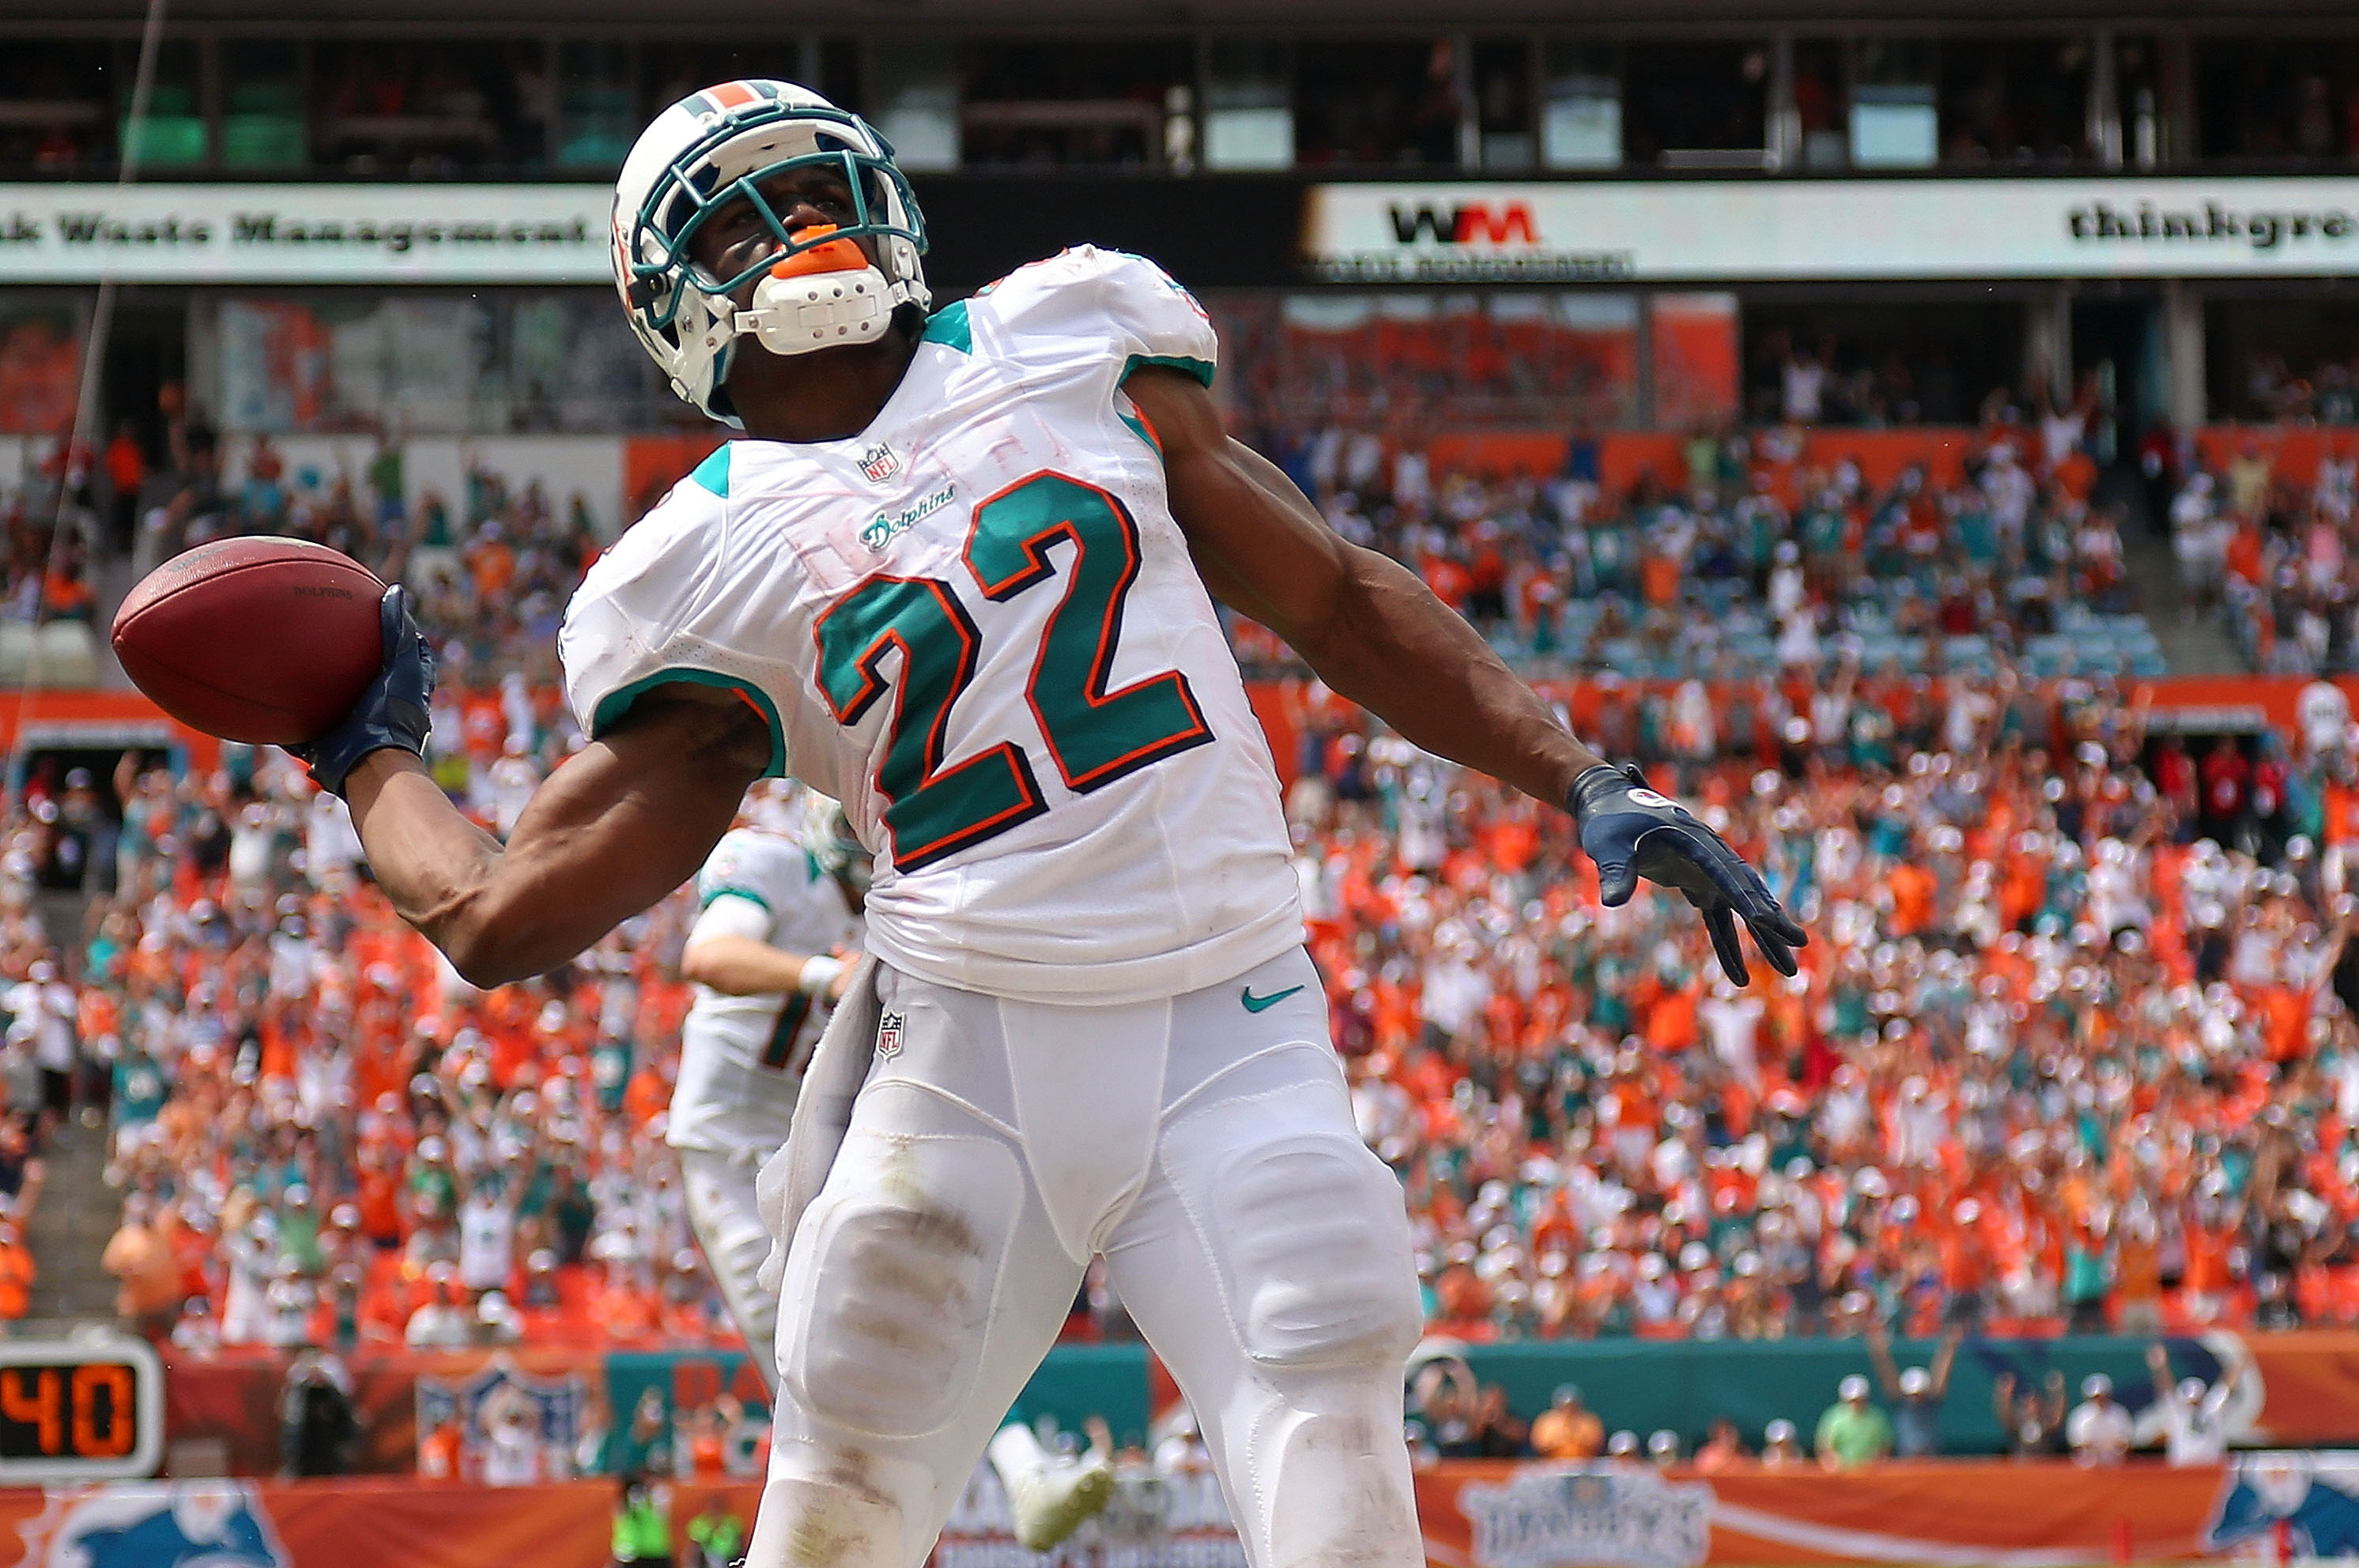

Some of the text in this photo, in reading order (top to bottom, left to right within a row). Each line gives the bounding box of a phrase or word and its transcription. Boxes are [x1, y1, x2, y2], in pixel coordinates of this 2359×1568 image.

[0, 210, 589, 253] k Waste Management
[1386, 203, 1539, 243] WM
[866, 456, 896, 480] NFL
[861, 484, 956, 550] Dolphins
[293, 586, 353, 601] DOLPHINS
[813, 468, 1216, 875] 22
[879, 1030, 900, 1050] NFL
[1, 1363, 136, 1458] 40
